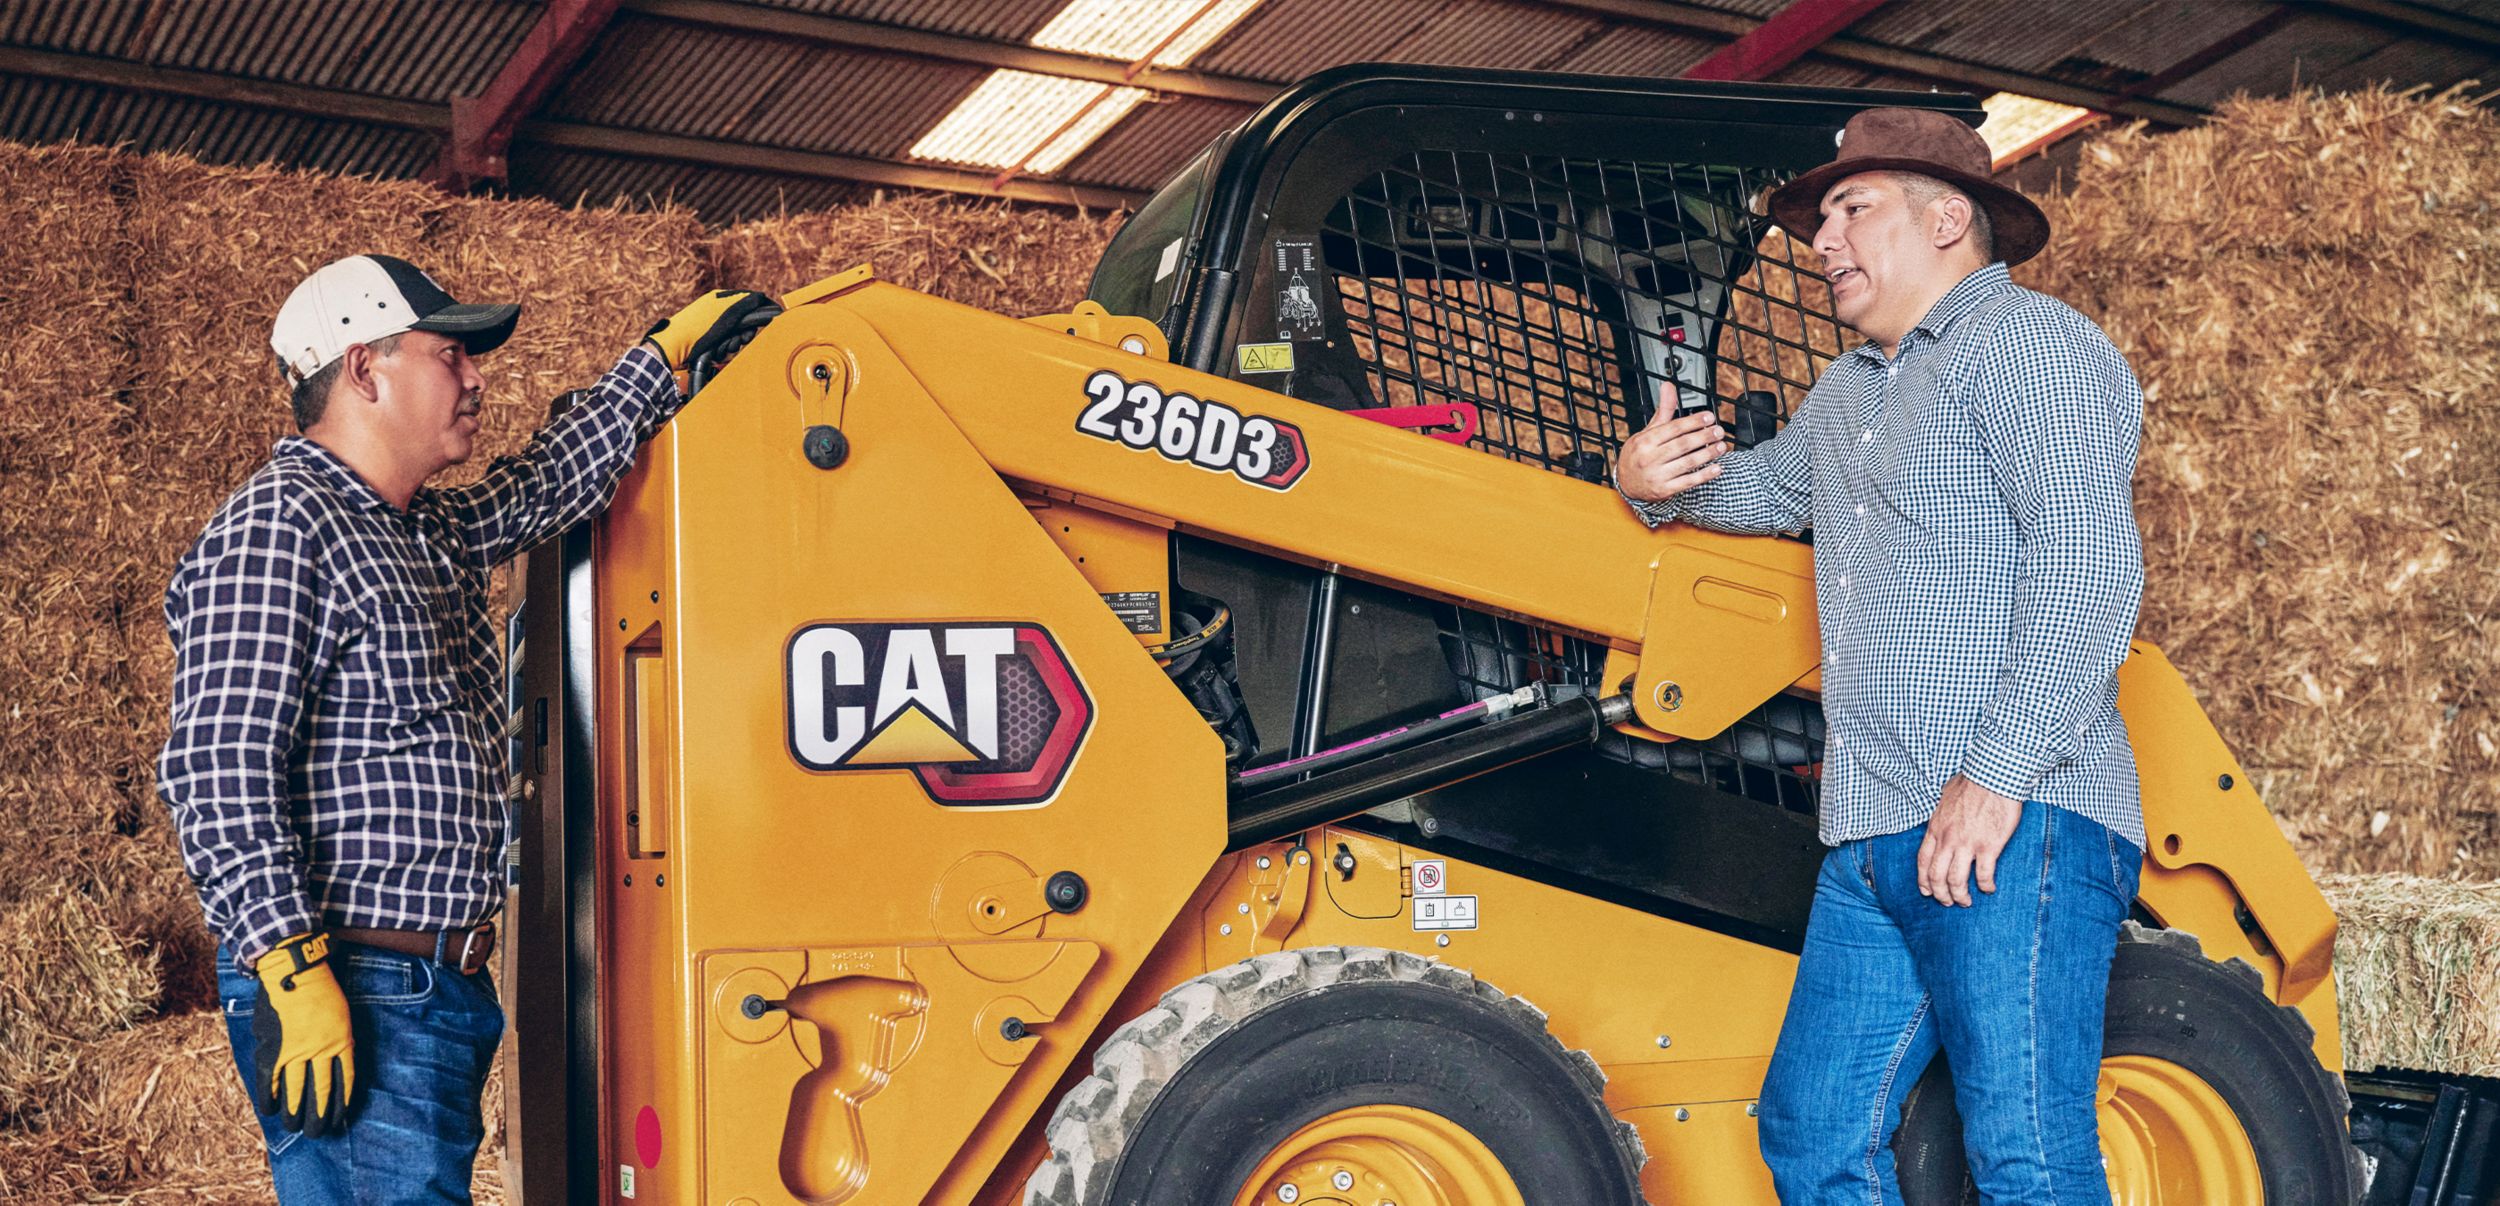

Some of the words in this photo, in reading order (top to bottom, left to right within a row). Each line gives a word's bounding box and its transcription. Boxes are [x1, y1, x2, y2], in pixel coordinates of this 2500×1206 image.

[1080, 373, 1277, 479] 236D3
[792, 627, 1015, 764] CAT
[301, 932, 330, 964] CAT
